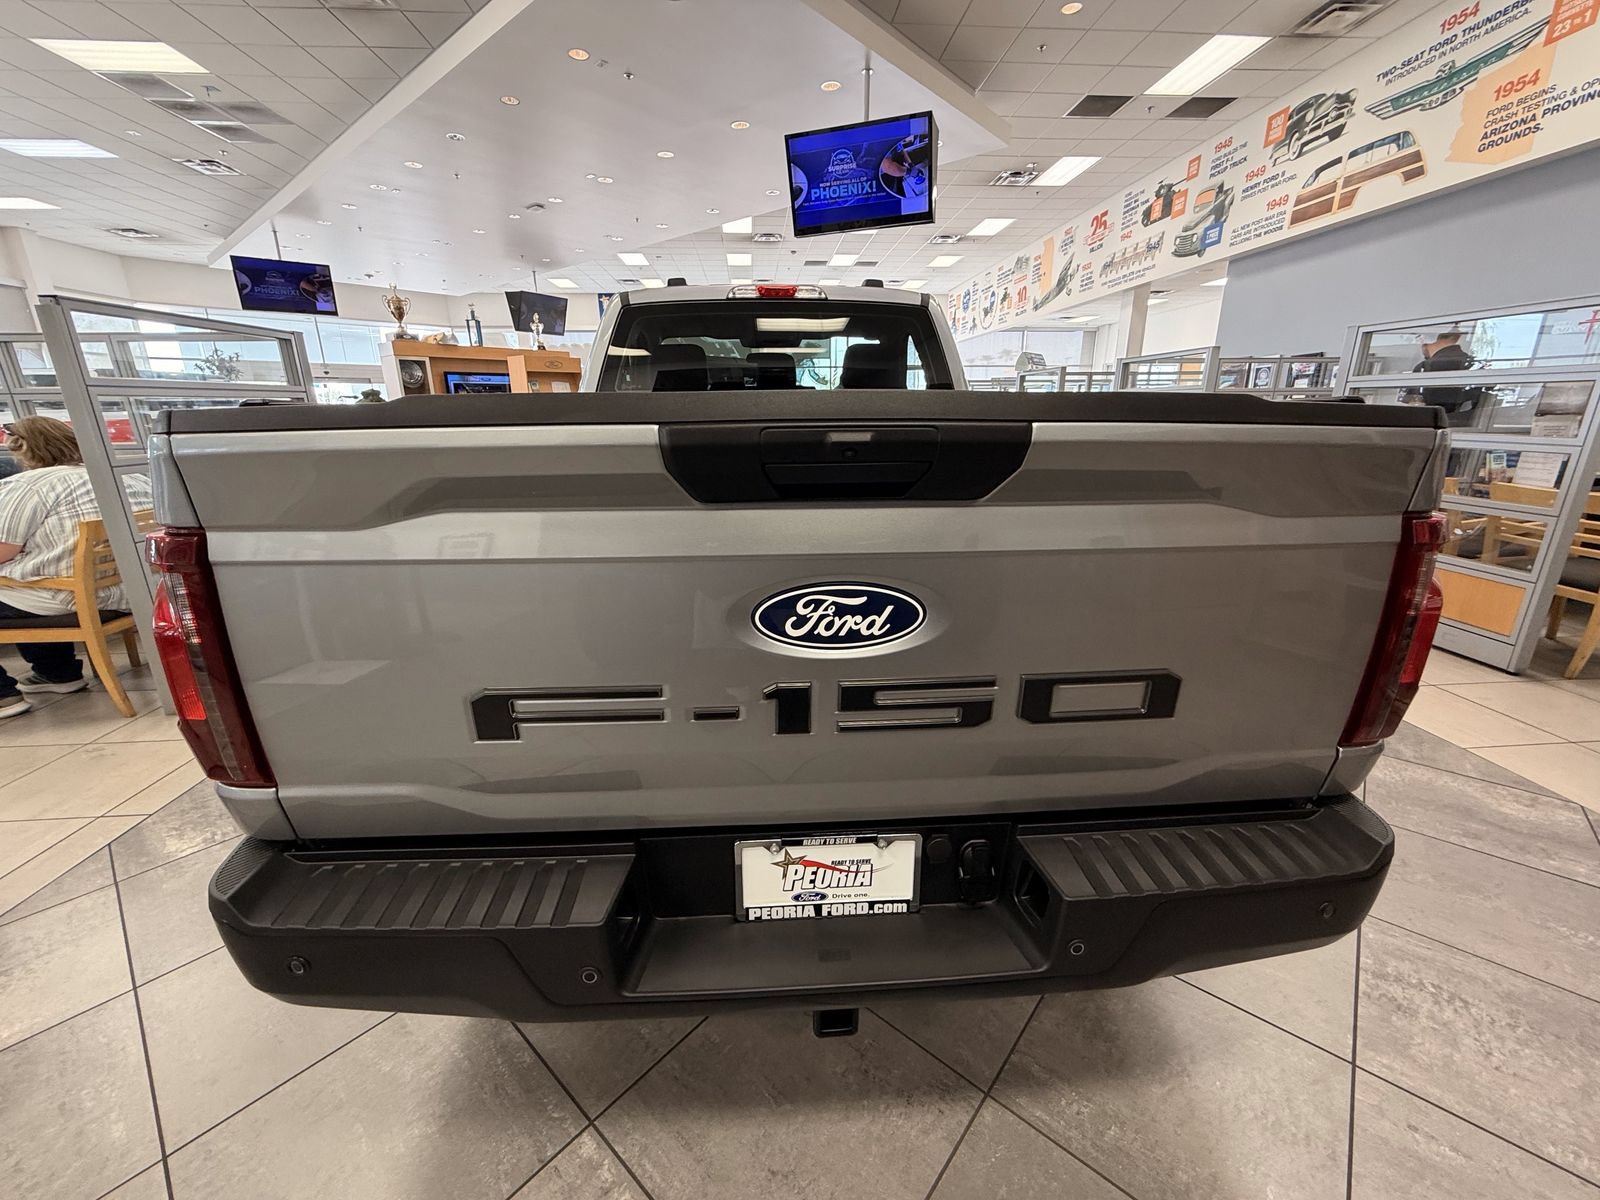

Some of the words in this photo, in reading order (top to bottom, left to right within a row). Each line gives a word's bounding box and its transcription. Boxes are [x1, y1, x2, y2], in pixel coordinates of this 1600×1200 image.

[1440, 1, 1480, 35] 1954
[1552, 19, 1572, 39] 23
[1584, 8, 1593, 24] 1
[1376, 49, 1427, 82] TWO-SEAT
[1427, 33, 1458, 56] FORD
[1461, 0, 1533, 38] THUNDERB
[1385, 54, 1437, 86] INTRODUCED
[1437, 49, 1447, 60] IN
[1448, 31, 1481, 56] NORTH
[1493, 68, 1541, 102] 1954
[1483, 110, 1519, 129] CRASH
[1520, 90, 1568, 115] TESTING
[1569, 86, 1578, 96] &
[1486, 101, 1515, 119] FORD
[1515, 83, 1557, 108] BEGINS
[1477, 122, 1545, 153] GROUNDS.
[1480, 113, 1537, 142] ARIZONA
[1214, 136, 1234, 154] 1948
[828, 161, 857, 172] SURPRISE
[1228, 154, 1248, 170] TRUCK
[1245, 165, 1266, 183] 1949
[811, 180, 877, 201] PHOENIX!
[1257, 184, 1270, 195] POST
[1262, 172, 1280, 186] FORD
[1266, 194, 1290, 212] 1949
[1090, 208, 1109, 237] 25
[1252, 216, 1287, 233] INTRODUCED
[785, 594, 895, 638] Ford
[469, 668, 1183, 744] F-150
[802, 838, 825, 847] READY
[824, 838, 835, 846] TO
[834, 836, 857, 845] SERVE
[830, 858, 848, 866] READY
[855, 857, 872, 865] SERVE
[783, 862, 874, 892] PEORIA
[853, 891, 871, 899] one.
[748, 905, 816, 921] PEORIA
[821, 901, 909, 917] FORD.com
